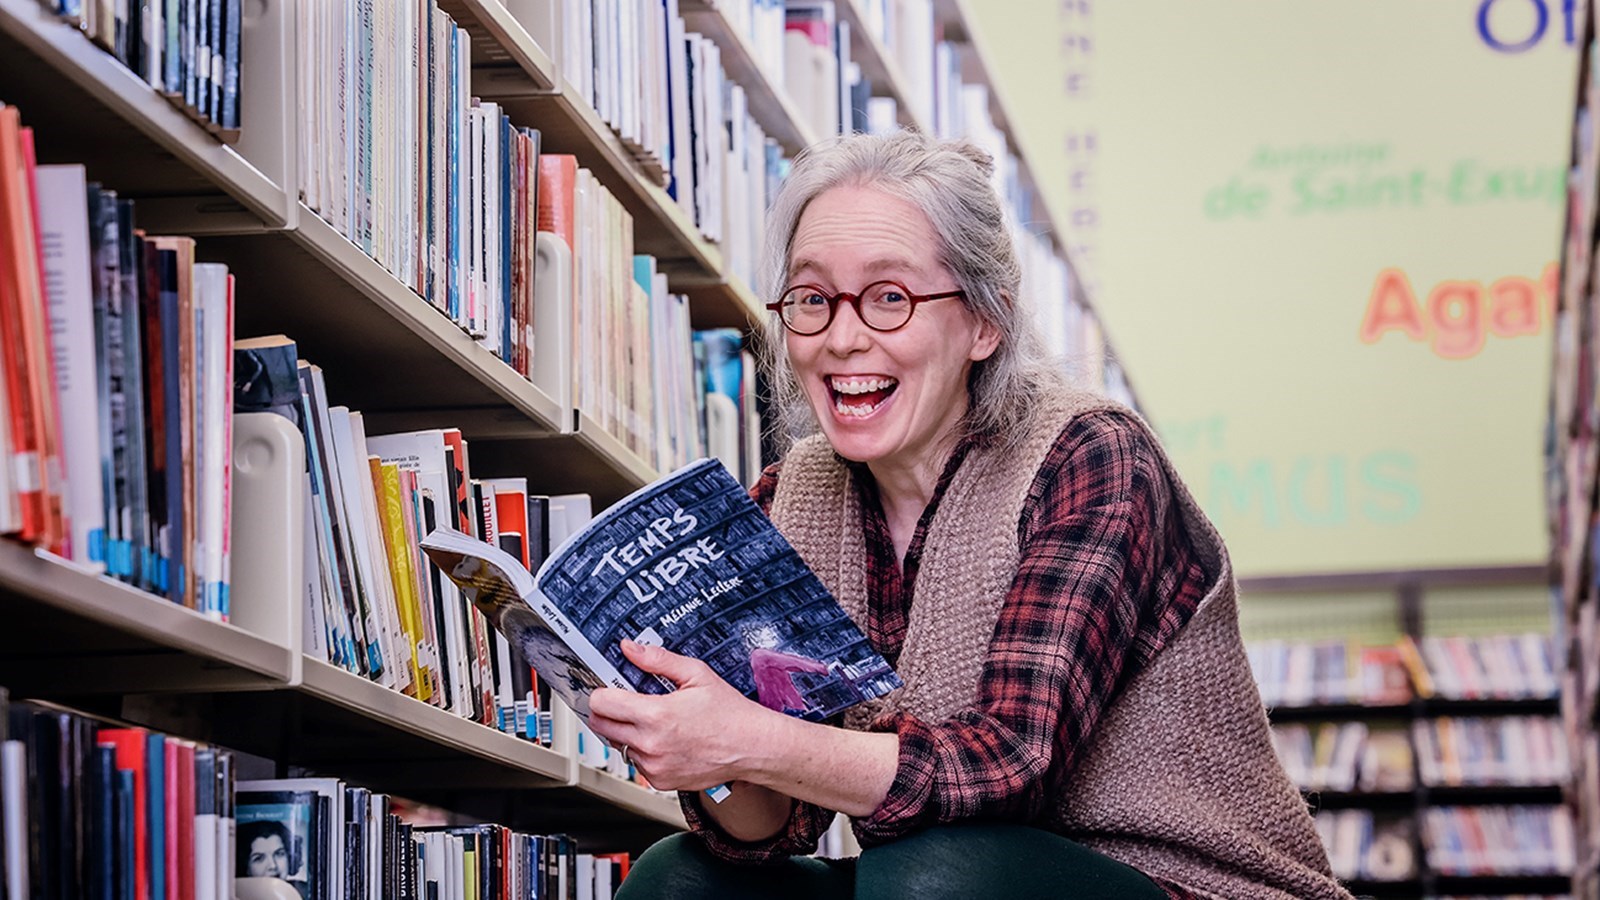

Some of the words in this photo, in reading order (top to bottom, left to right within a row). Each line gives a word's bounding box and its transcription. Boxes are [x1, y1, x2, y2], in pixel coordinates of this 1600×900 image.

[1204, 176, 1270, 220] de
[1206, 448, 1423, 529] MUS
[591, 508, 698, 577] TEMPS
